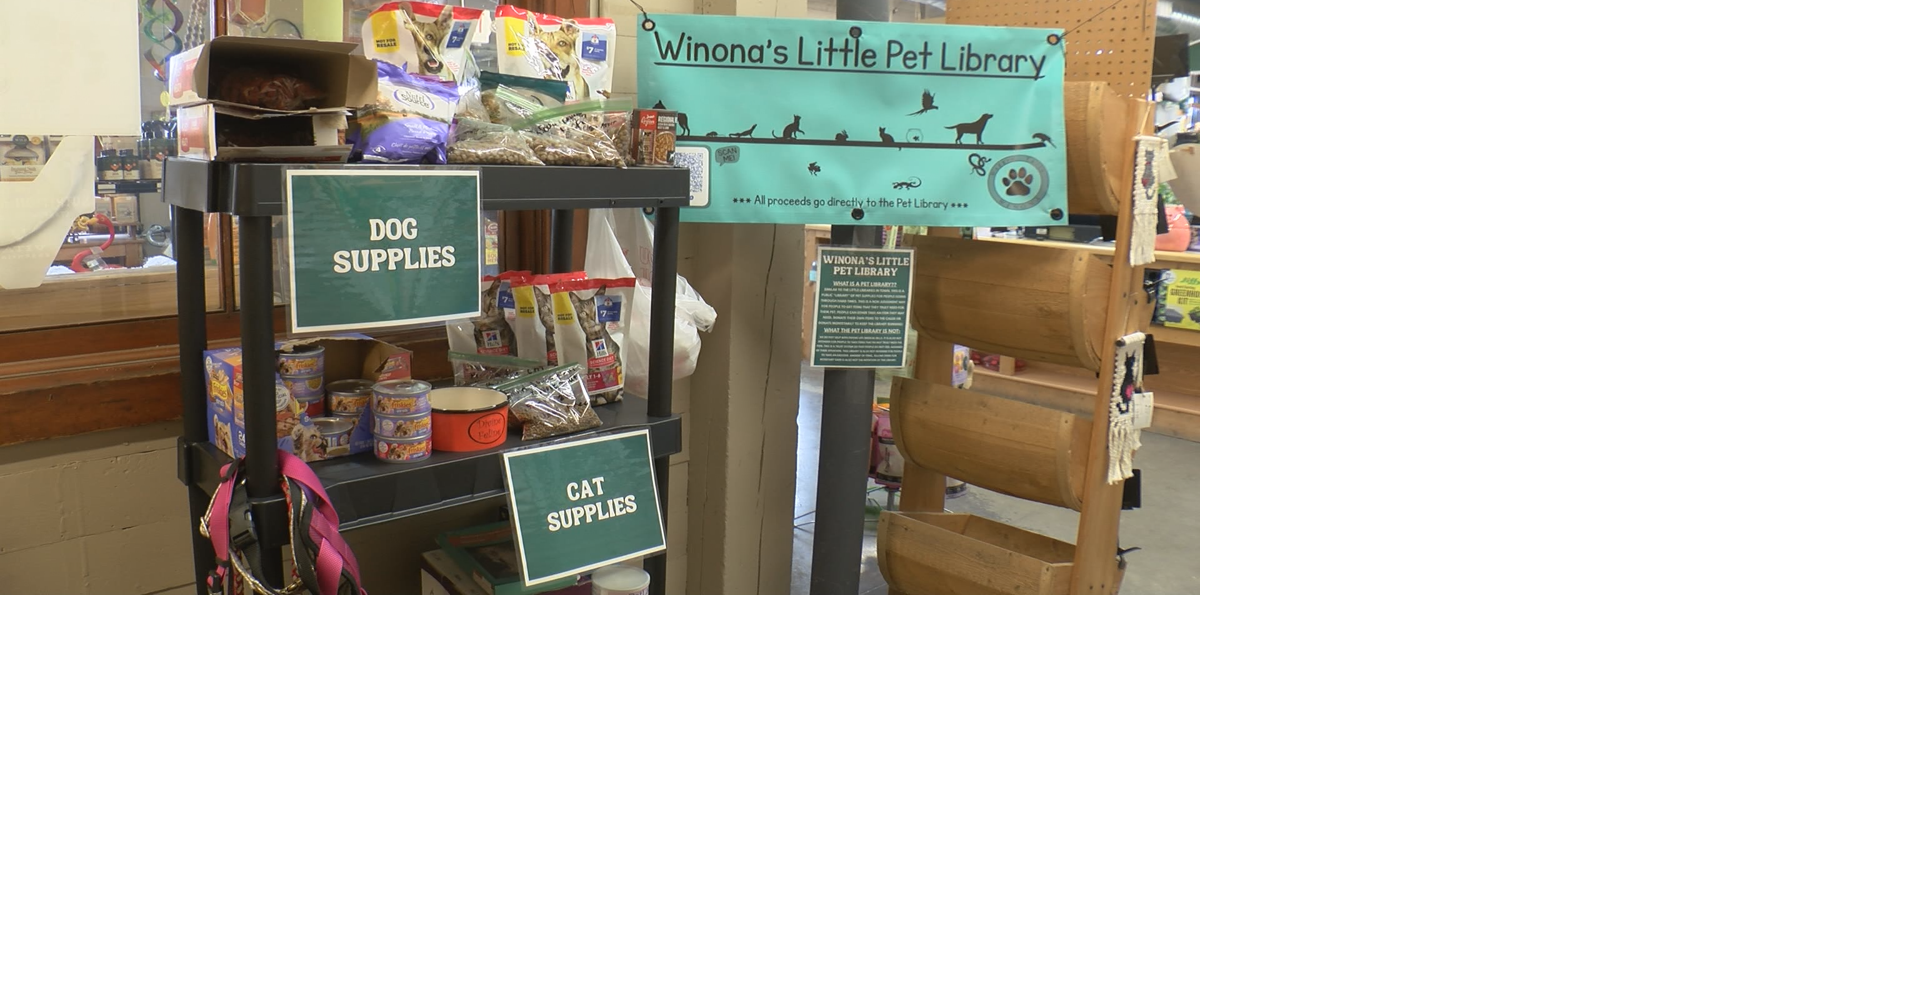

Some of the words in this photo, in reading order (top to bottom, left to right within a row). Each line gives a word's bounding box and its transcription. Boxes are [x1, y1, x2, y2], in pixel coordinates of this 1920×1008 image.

[654, 31, 788, 64] Winona's
[798, 36, 877, 67] Little
[886, 39, 933, 70] Pet
[940, 42, 1046, 80] Library
[717, 147, 737, 156] SCAN
[722, 154, 736, 162] ME!
[754, 195, 766, 205] All
[767, 196, 811, 207] proceeds
[813, 199, 825, 208] go
[827, 197, 863, 208] directly
[866, 198, 876, 207] to
[878, 198, 894, 208] the
[896, 198, 912, 208] Pet
[914, 198, 948, 211] Library
[369, 217, 418, 241] DOG
[333, 245, 456, 274] SUPPLIES
[823, 255, 874, 265] WINONA'S
[876, 256, 910, 266] LITTLE
[834, 266, 853, 276] PET
[854, 267, 898, 276] LIBRARY
[567, 476, 604, 501] CAT
[547, 494, 638, 532] SUPPLIES
